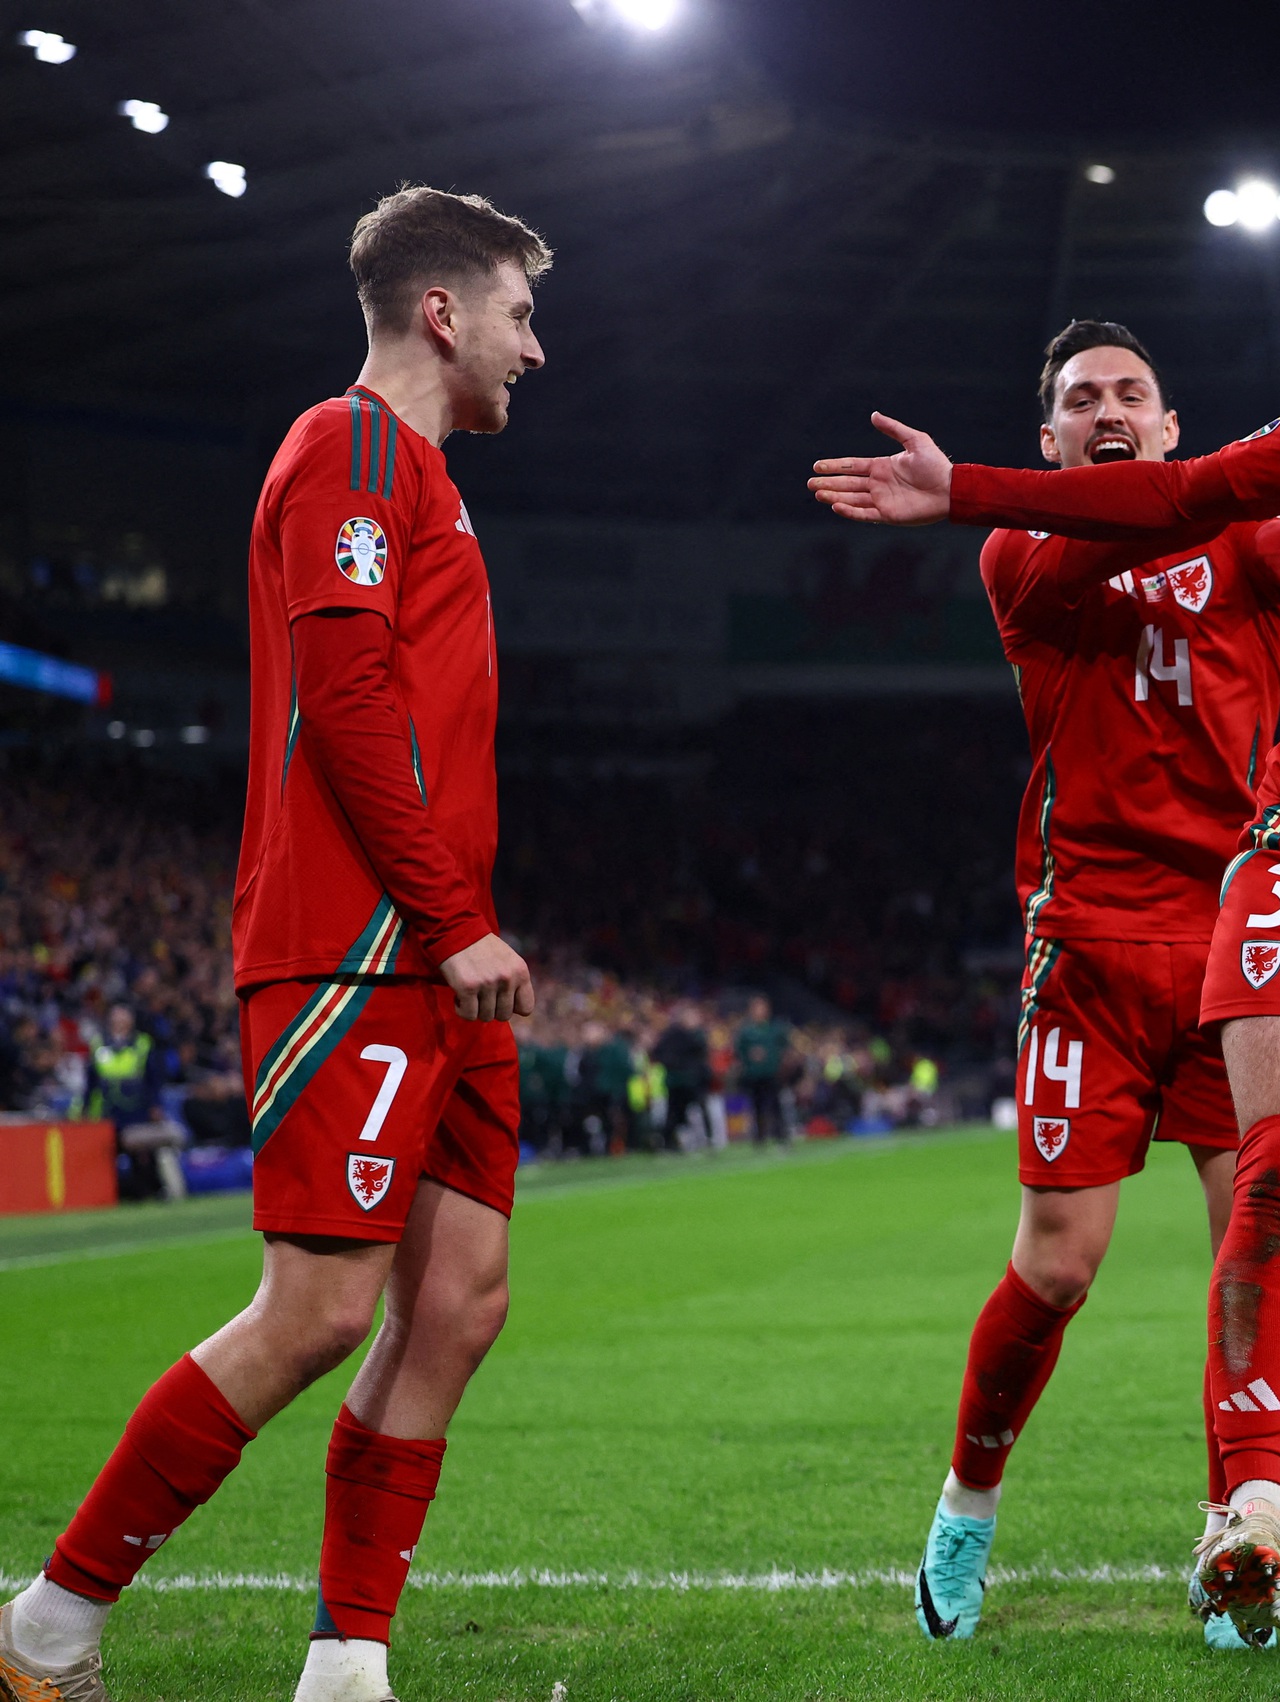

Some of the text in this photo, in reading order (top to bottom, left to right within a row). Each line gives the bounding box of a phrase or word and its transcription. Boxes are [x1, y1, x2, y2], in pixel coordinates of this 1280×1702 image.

[1134, 623, 1194, 706] 14
[358, 1043, 409, 1142] 7
[1024, 1025, 1084, 1109] 14
